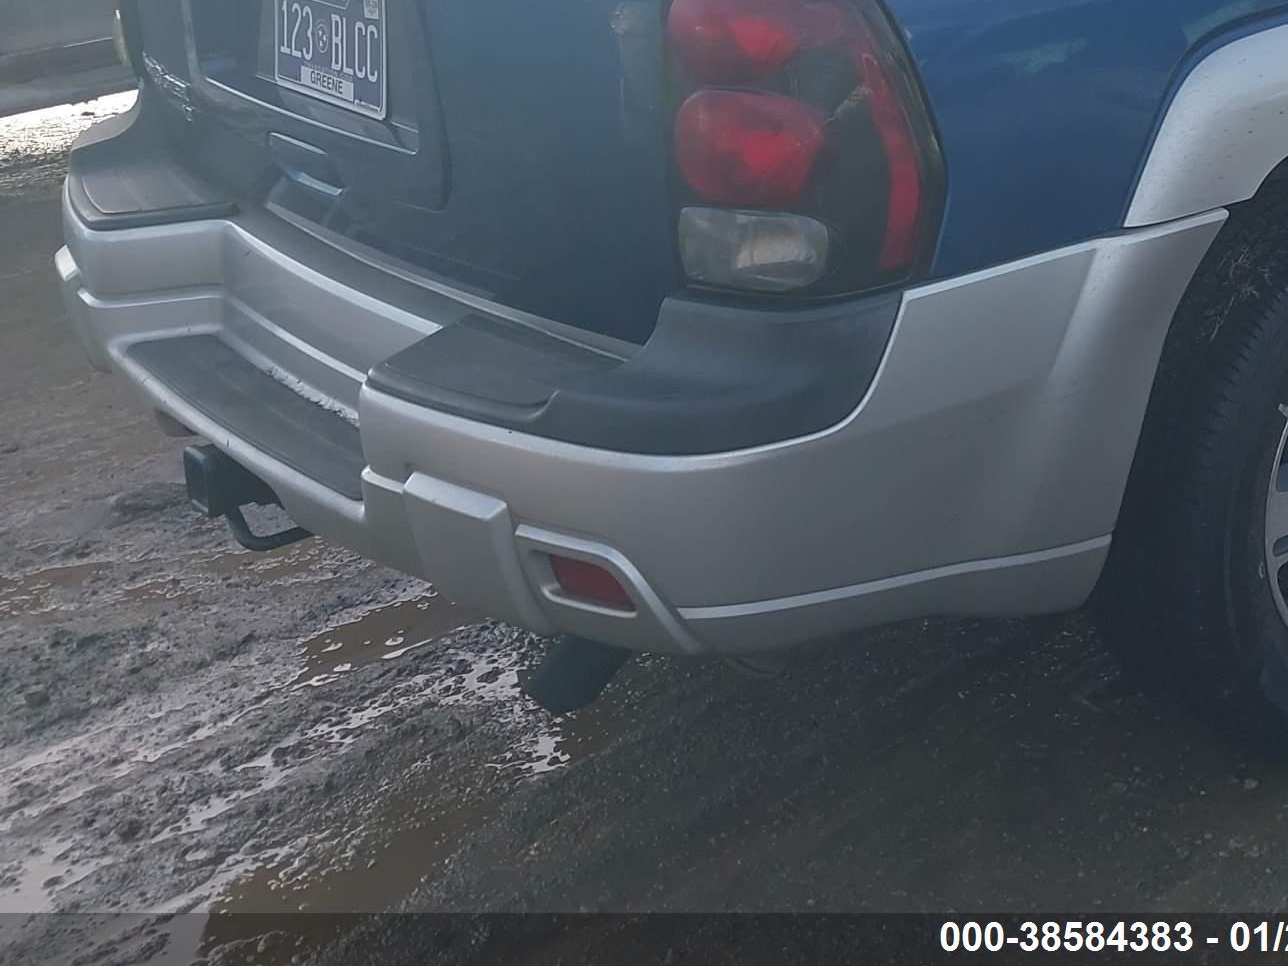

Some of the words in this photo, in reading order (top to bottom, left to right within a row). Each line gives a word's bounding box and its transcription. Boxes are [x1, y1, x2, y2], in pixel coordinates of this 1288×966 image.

[280, 0, 313, 61] 123
[330, 14, 378, 83] BLCC
[310, 70, 344, 95] GREENE
